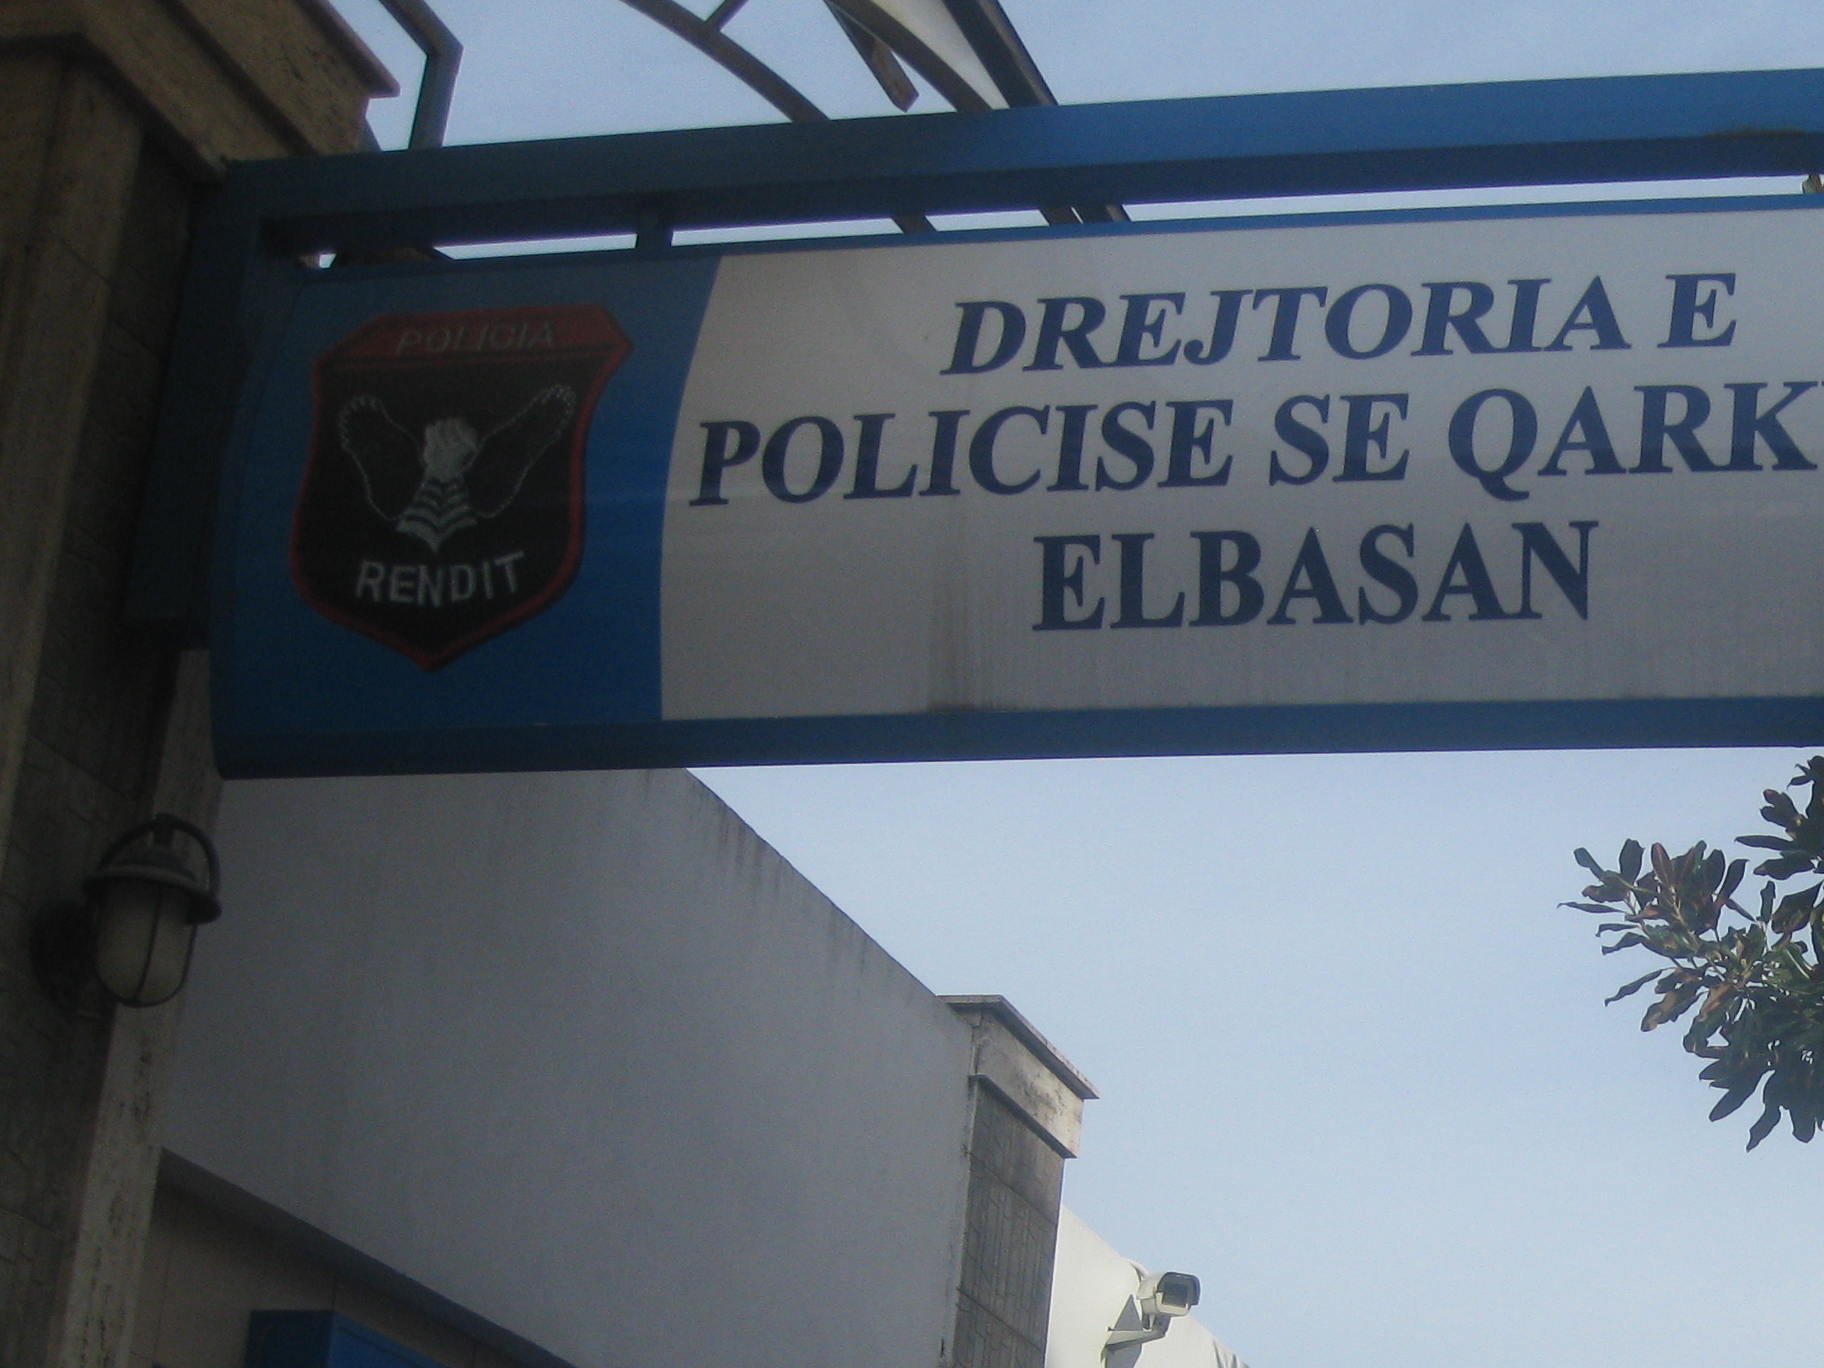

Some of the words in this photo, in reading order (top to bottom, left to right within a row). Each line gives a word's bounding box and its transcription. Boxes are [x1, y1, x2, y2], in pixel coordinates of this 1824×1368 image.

[394, 320, 557, 357] POLICIA
[938, 275, 1632, 377] DREJTORIA
[1656, 272, 1737, 349] E
[686, 399, 1234, 510] POLICISE
[1268, 393, 1410, 487] SE
[356, 550, 525, 608] RENDIT
[1031, 521, 1599, 632] ELBASAN
